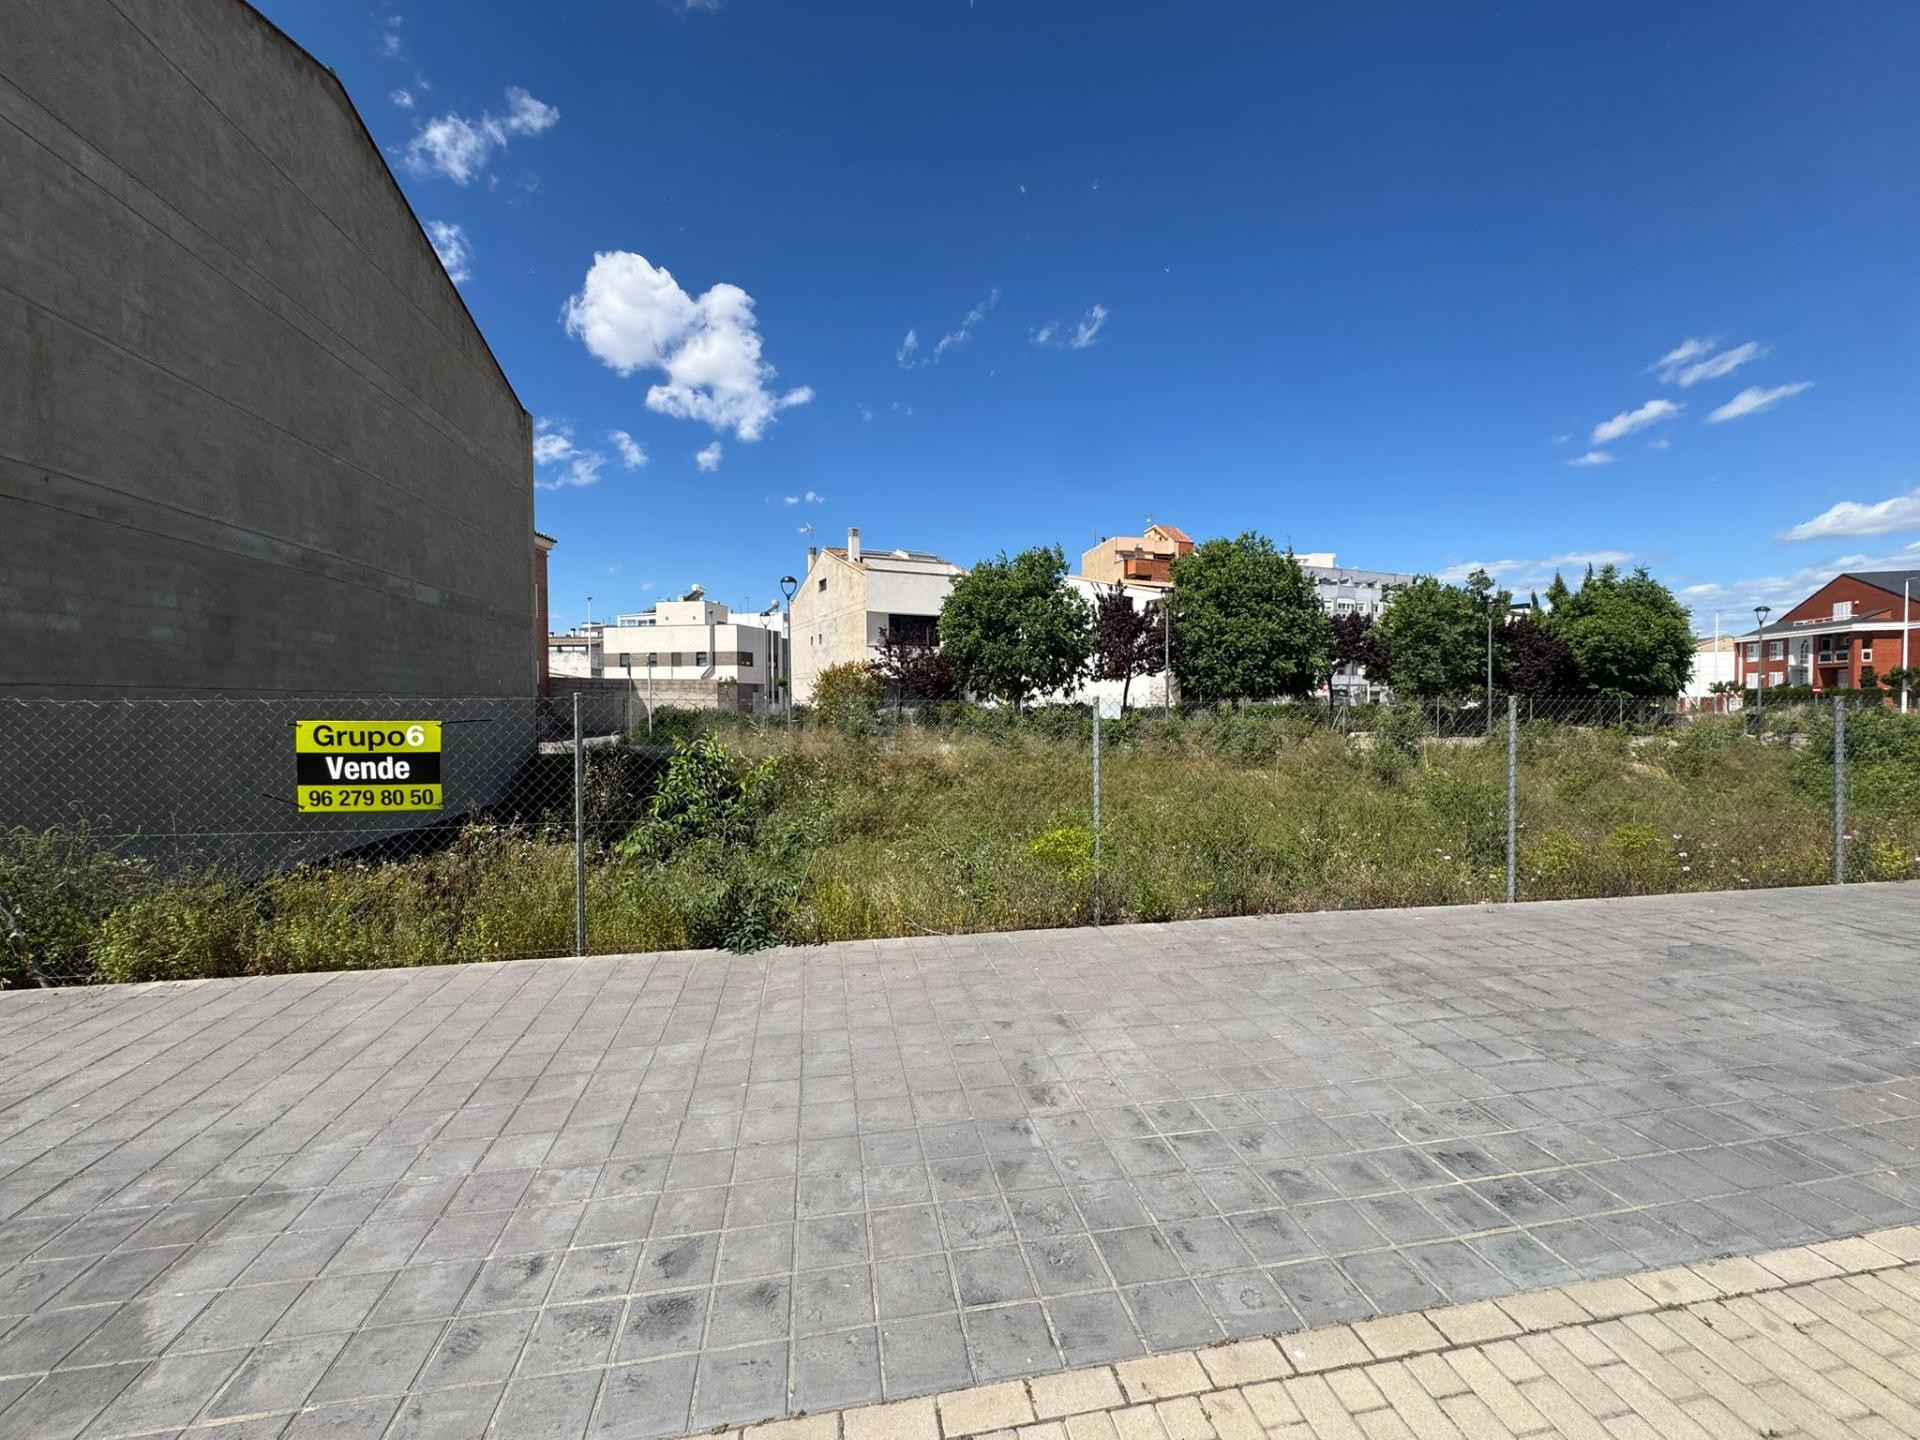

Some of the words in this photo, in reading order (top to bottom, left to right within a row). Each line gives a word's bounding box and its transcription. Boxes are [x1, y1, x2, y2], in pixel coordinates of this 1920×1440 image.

[313, 725, 425, 751] Grupo6
[325, 756, 410, 780] Vende
[309, 790, 333, 807] 96
[339, 790, 374, 806] 279
[381, 789, 404, 806] 80
[411, 789, 434, 805] 50
